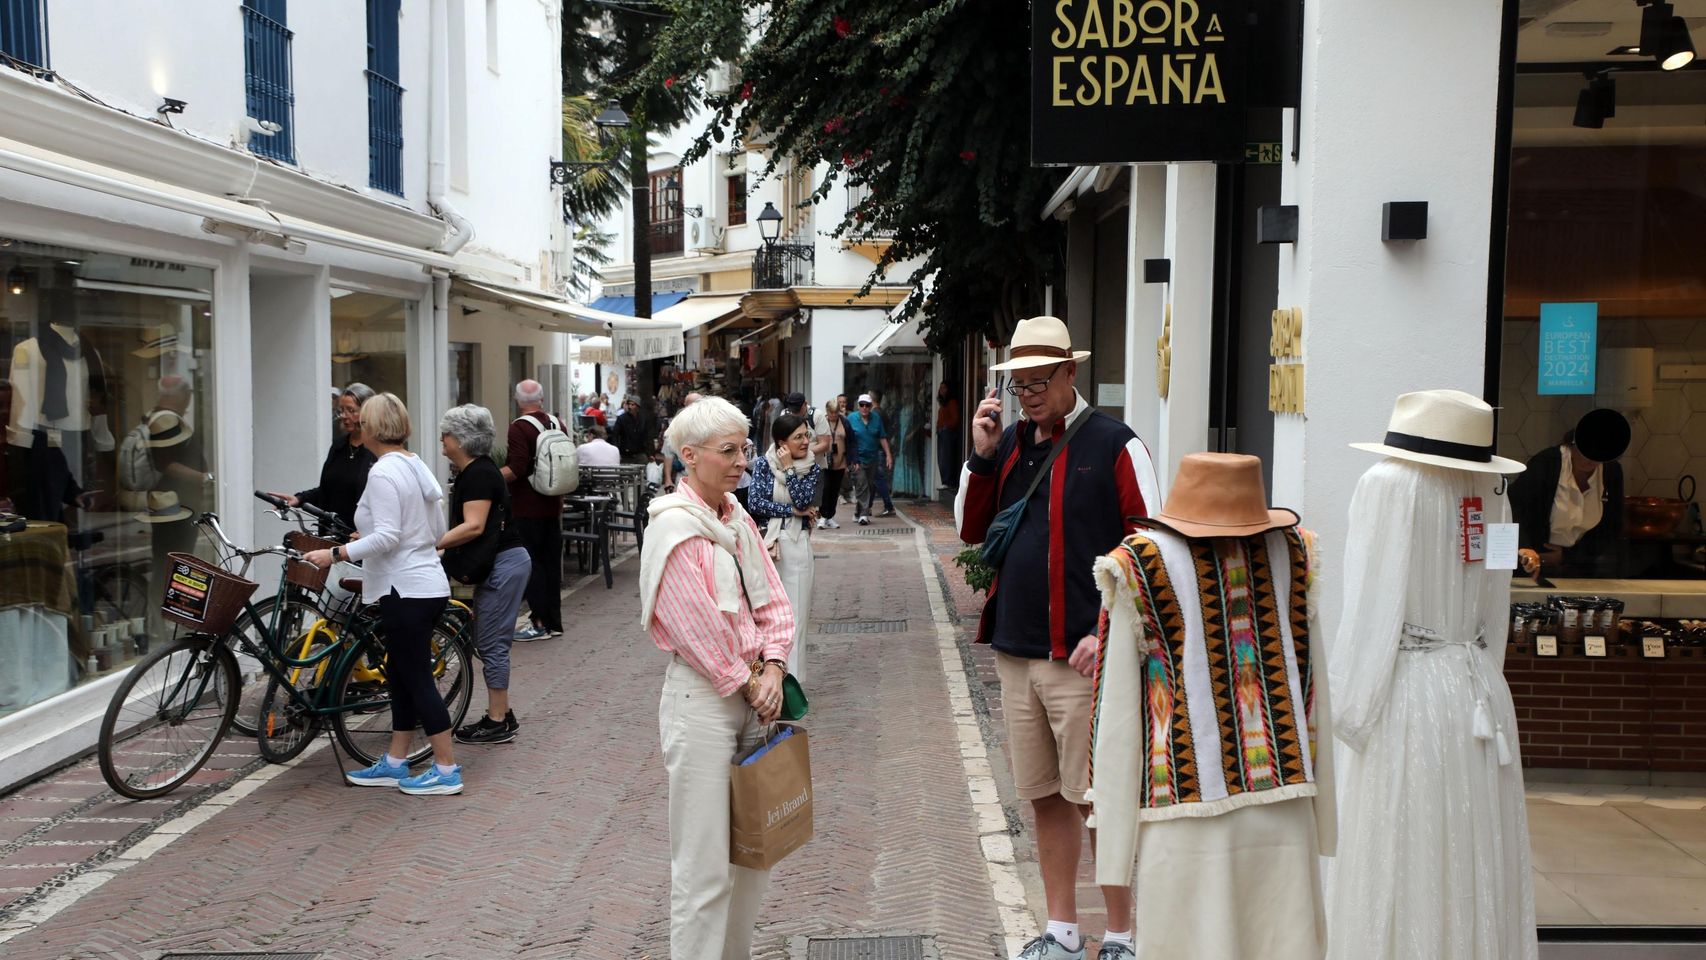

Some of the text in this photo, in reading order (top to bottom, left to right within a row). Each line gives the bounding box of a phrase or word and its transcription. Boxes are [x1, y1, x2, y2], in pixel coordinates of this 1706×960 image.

[1051, 0, 1225, 49] SABOR A
[1052, 53, 1226, 106] ESPAÑA
[1544, 331, 1591, 340] EUROPEAN
[1544, 340, 1589, 354] BEST
[1543, 361, 1590, 377] 2024
